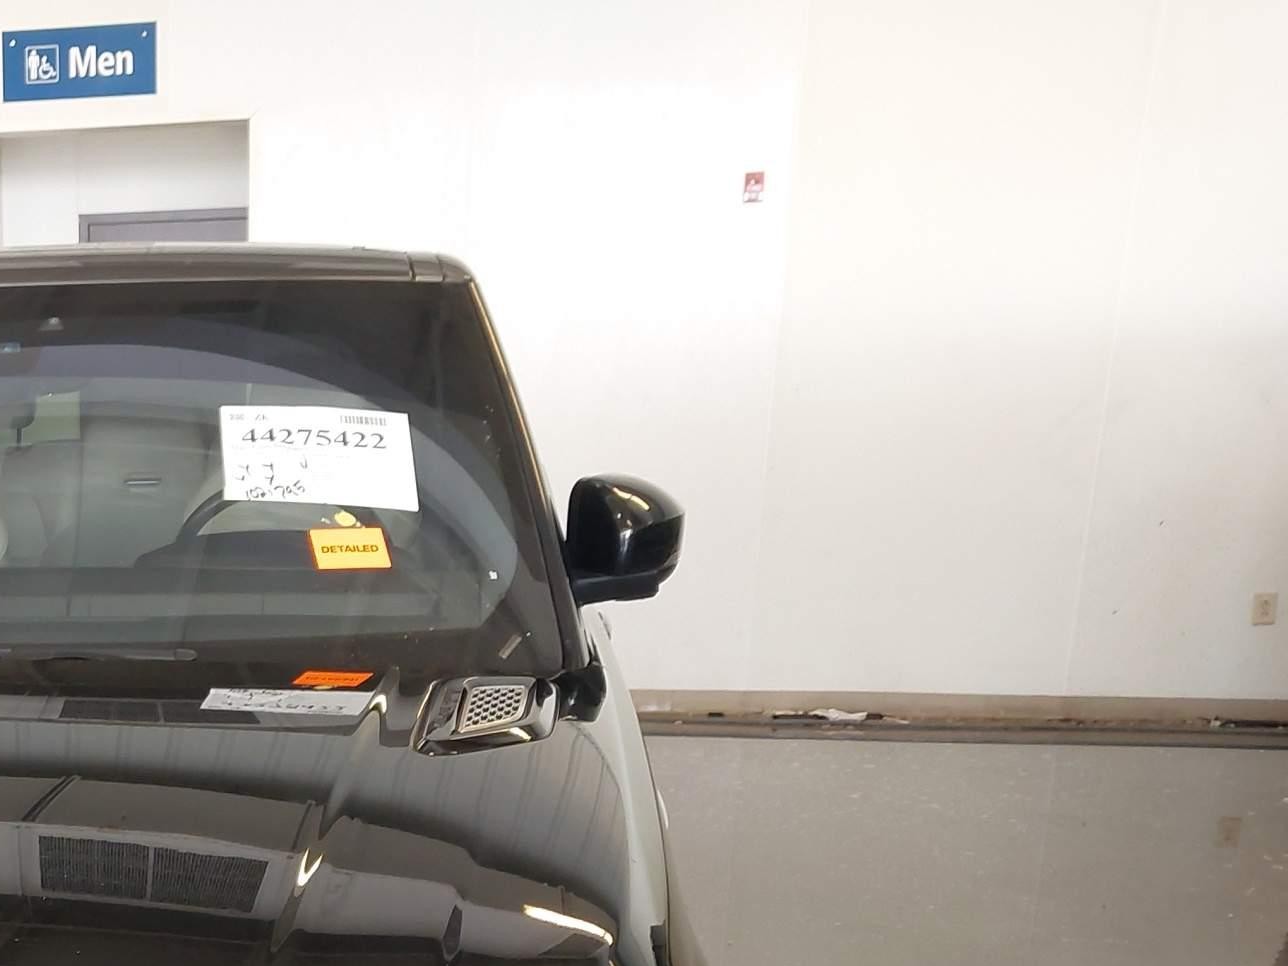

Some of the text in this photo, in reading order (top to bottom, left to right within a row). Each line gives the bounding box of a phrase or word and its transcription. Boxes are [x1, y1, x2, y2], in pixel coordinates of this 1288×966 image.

[68, 45, 134, 79] Men
[241, 427, 388, 449] 44275422
[320, 544, 380, 554] DETAILED
